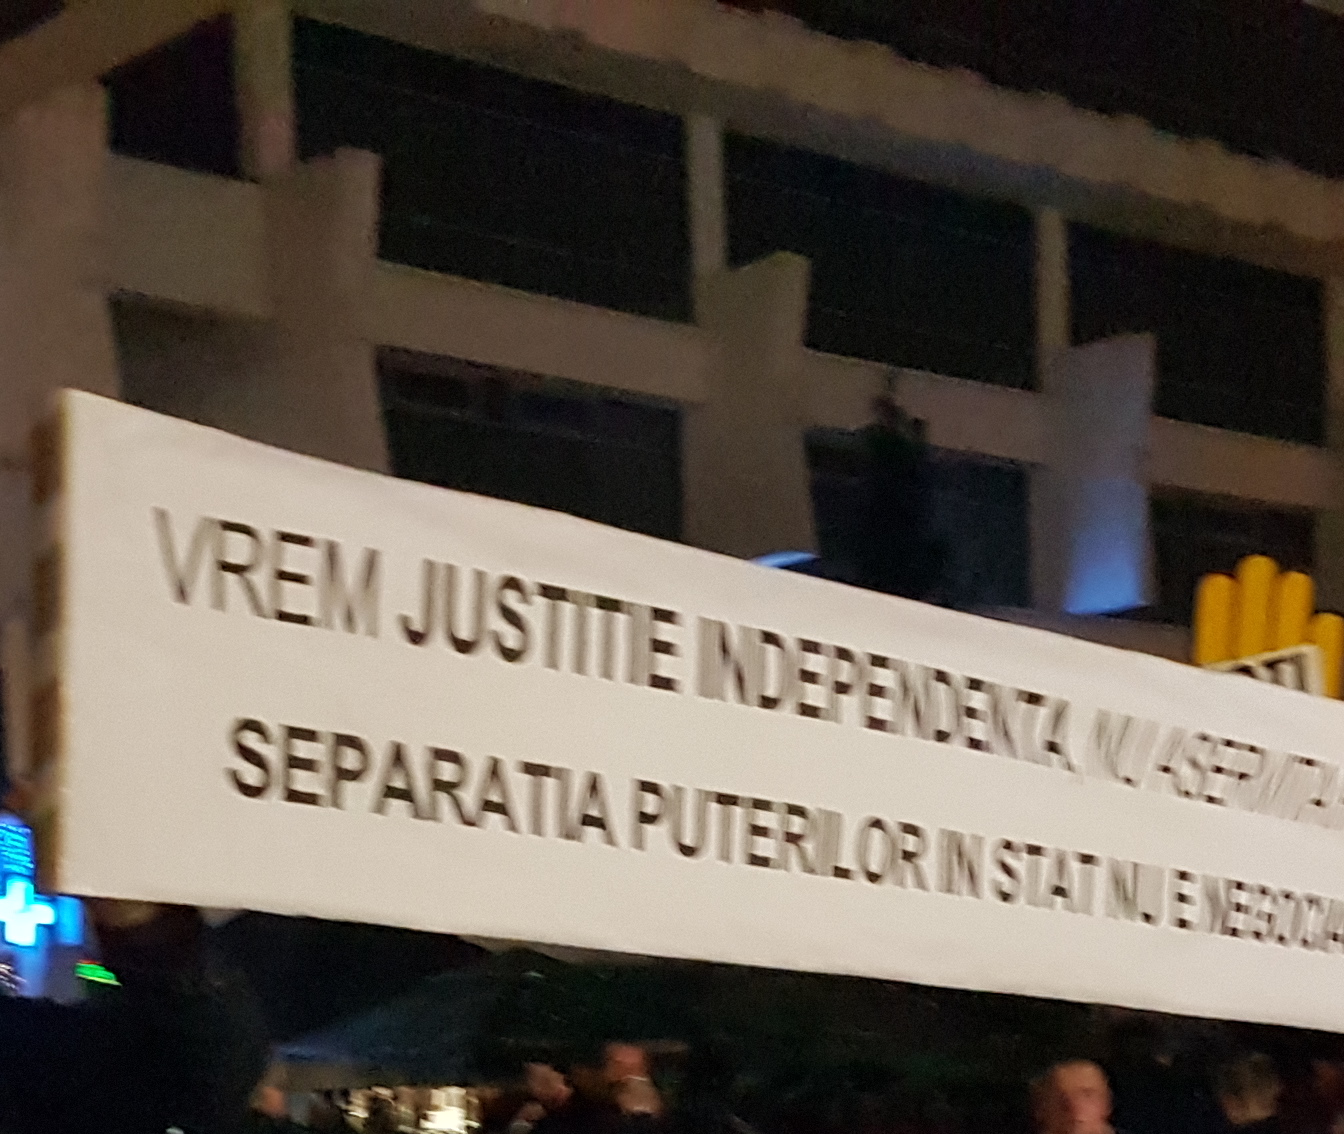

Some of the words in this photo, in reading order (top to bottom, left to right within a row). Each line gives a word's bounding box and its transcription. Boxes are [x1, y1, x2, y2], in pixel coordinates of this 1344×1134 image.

[152, 506, 382, 638] VREM
[398, 557, 681, 693] JUSTITIE
[224, 715, 619, 848] SEPARATIA
[630, 777, 930, 893] PUTERILOR
[936, 826, 986, 900] IN
[991, 836, 1100, 917] STAT
[1102, 855, 1164, 927] NU
[1167, 866, 1198, 932] E
